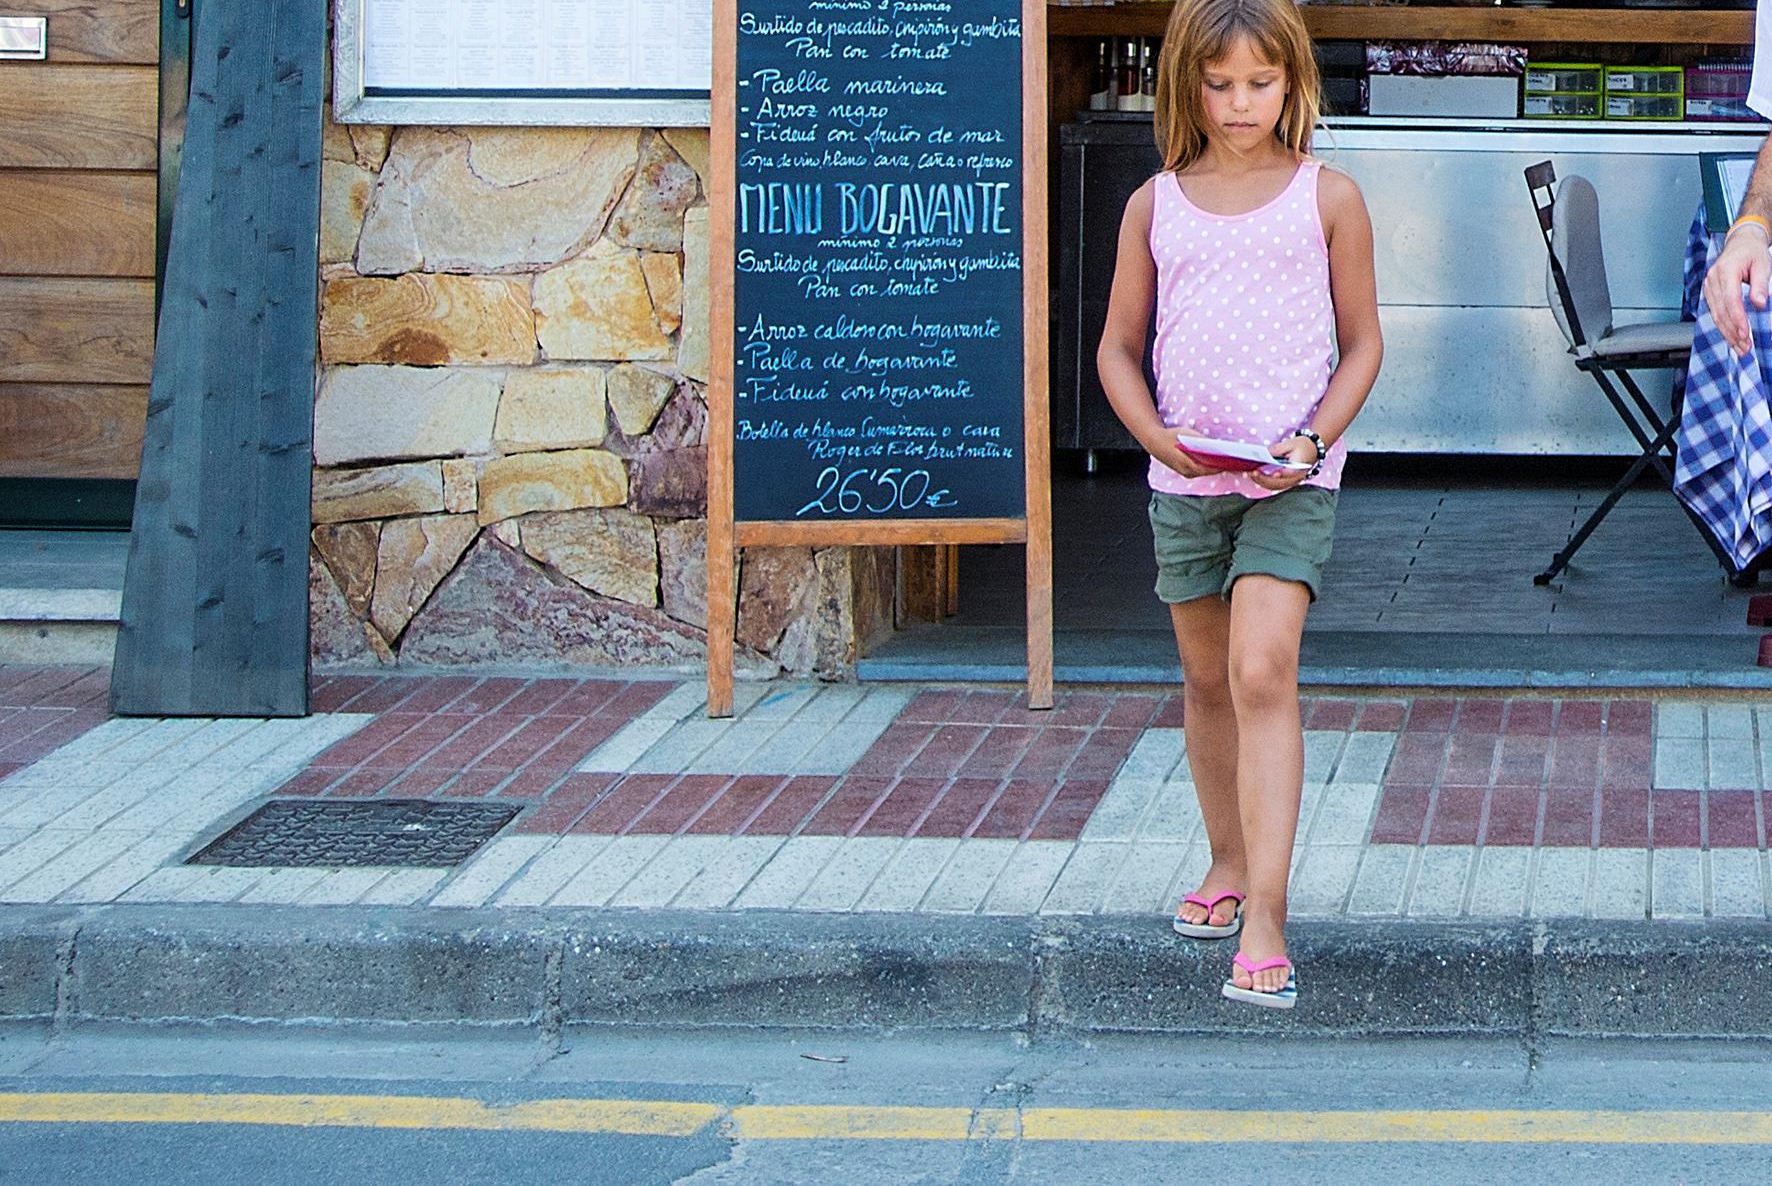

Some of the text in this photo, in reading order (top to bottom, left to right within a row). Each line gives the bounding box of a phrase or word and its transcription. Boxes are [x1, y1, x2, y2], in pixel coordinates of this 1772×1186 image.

[740, 12, 823, 35] Surtido de
[785, 36, 952, 59] Pan con tomate
[753, 68, 947, 96] Paella marinera
[757, 97, 888, 127] Arroz negro
[827, 128, 858, 142] con
[864, 121, 921, 153] frutos
[928, 125, 954, 143] de
[960, 129, 1005, 143] mar
[740, 183, 1011, 235] MENU BOGAVANTE
[737, 249, 818, 273] Surtido de
[798, 274, 939, 299] Pan con tomate
[748, 314, 1001, 347] Arroz bogavante
[744, 342, 813, 370] Paella
[823, 351, 845, 369] de
[793, 422, 809, 439] de
